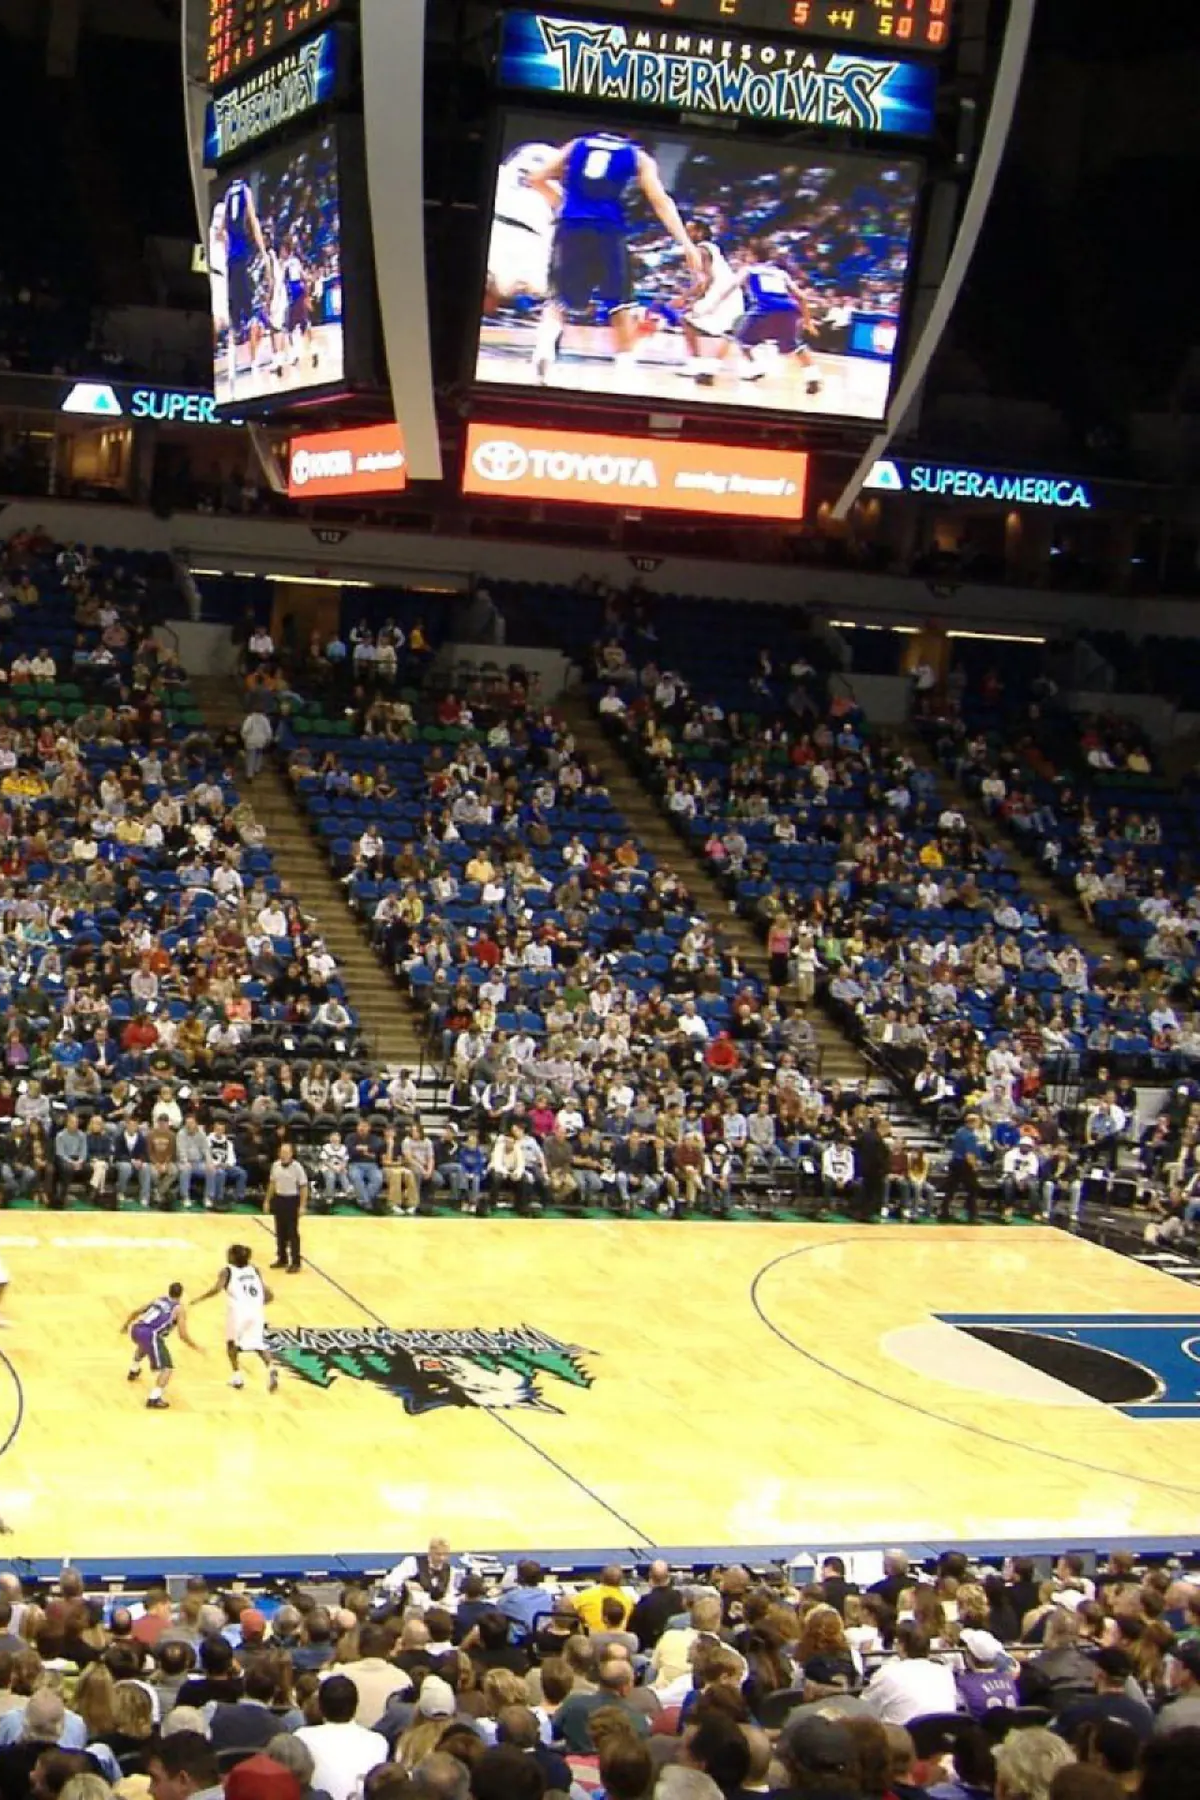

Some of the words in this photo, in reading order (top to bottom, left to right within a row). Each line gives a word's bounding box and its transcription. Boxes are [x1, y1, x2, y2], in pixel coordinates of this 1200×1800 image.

[793, 2, 809, 25] 5
[827, 10, 854, 30] +4
[634, 29, 817, 69] MINNESOTA
[536, 15, 900, 131] TIMBERWOLVES
[528, 449, 658, 488] TOYOTA
[910, 466, 1091, 508] SUPERAMERICA
